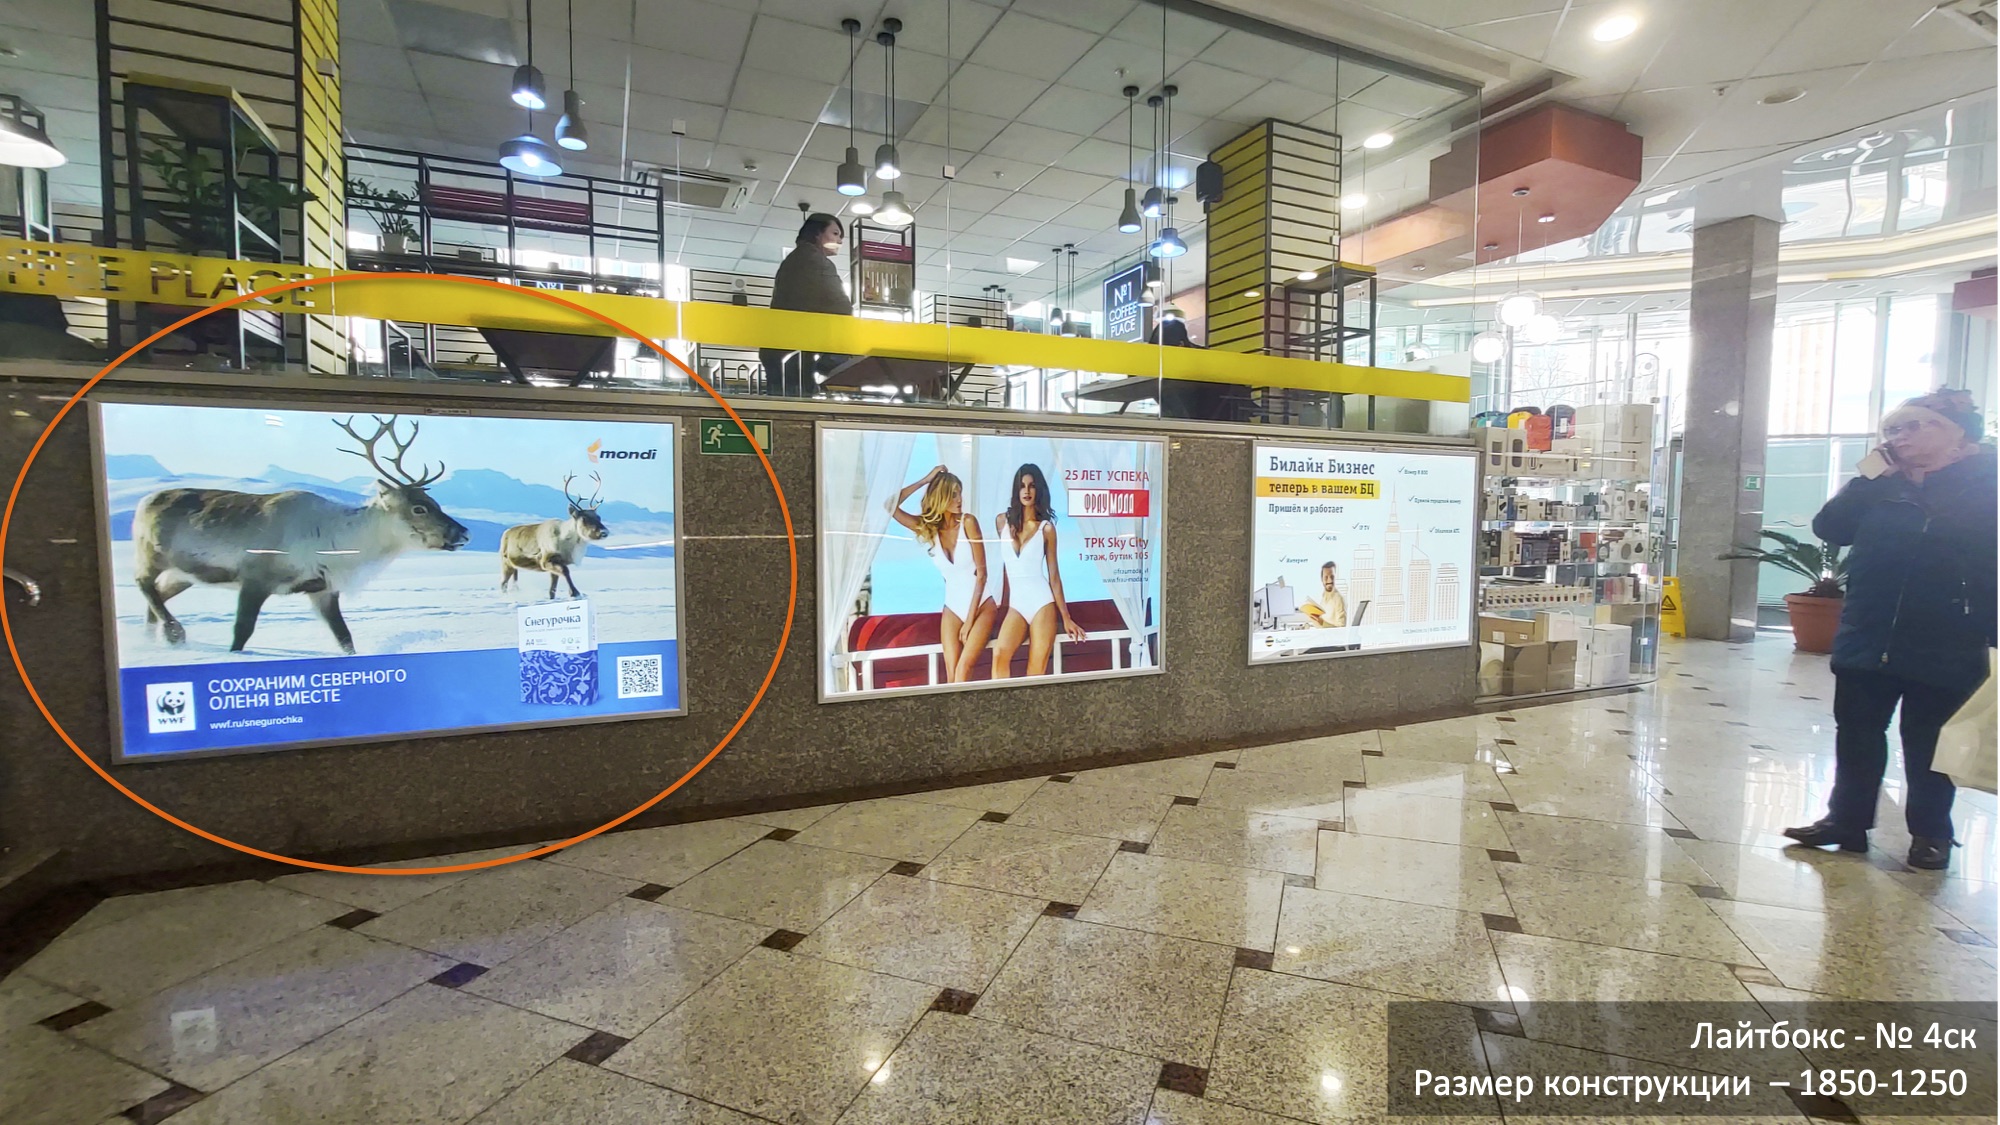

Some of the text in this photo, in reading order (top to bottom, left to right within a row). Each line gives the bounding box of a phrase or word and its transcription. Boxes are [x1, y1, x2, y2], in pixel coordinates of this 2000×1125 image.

[149, 259, 316, 308] PLACE
[1109, 301, 1138, 323] COFFEE
[1110, 317, 1136, 338] PLACE
[599, 448, 658, 461] mondi
[1269, 456, 1375, 475] Билайн Бизнес
[1065, 470, 1150, 482] 25 ЛЕТ УСПЕХА
[1269, 482, 1375, 497] теперь в вашем БЦ
[1268, 503, 1343, 515] Пришёл и работает
[1085, 537, 1149, 550] ТРК Sky City
[1079, 553, 1083, 561] 1
[1084, 554, 1108, 562] этаж,
[1109, 552, 1133, 563] бутик
[525, 614, 582, 628] Снегурочка
[208, 668, 407, 694] СОХРАНИМ СЕВЕРНОГО
[208, 689, 341, 711] ОЛЕНЯ ВМЕСТЕ
[157, 716, 186, 725] WWF
[209, 715, 304, 730] wwf.ru/snegurochka
